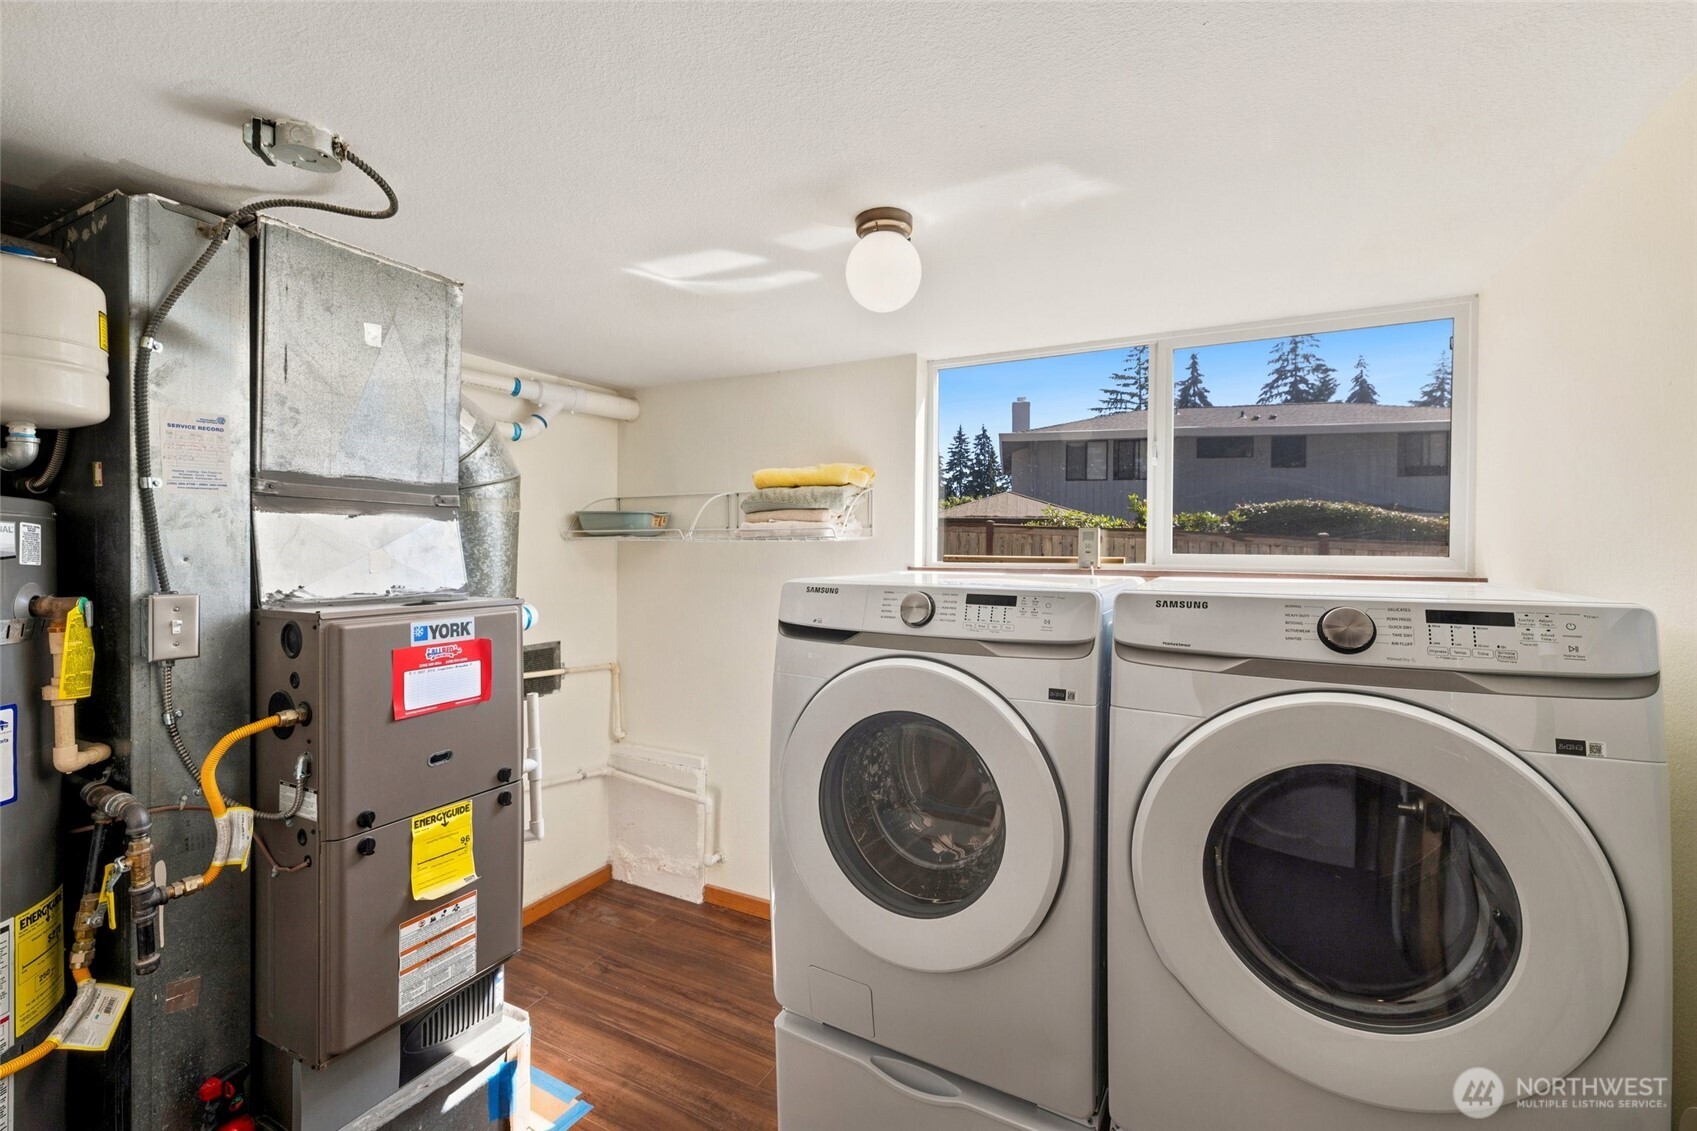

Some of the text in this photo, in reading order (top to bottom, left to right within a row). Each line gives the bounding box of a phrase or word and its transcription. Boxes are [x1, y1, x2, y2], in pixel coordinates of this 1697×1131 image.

[167, 422, 225, 433] SERVICE RECORD
[806, 586, 839, 595] SAMSUNG
[1155, 600, 1209, 610] SAMSUNG
[429, 621, 472, 640] YORK
[413, 803, 471, 830] ENERGYGUIDE
[460, 834, 471, 845] 96
